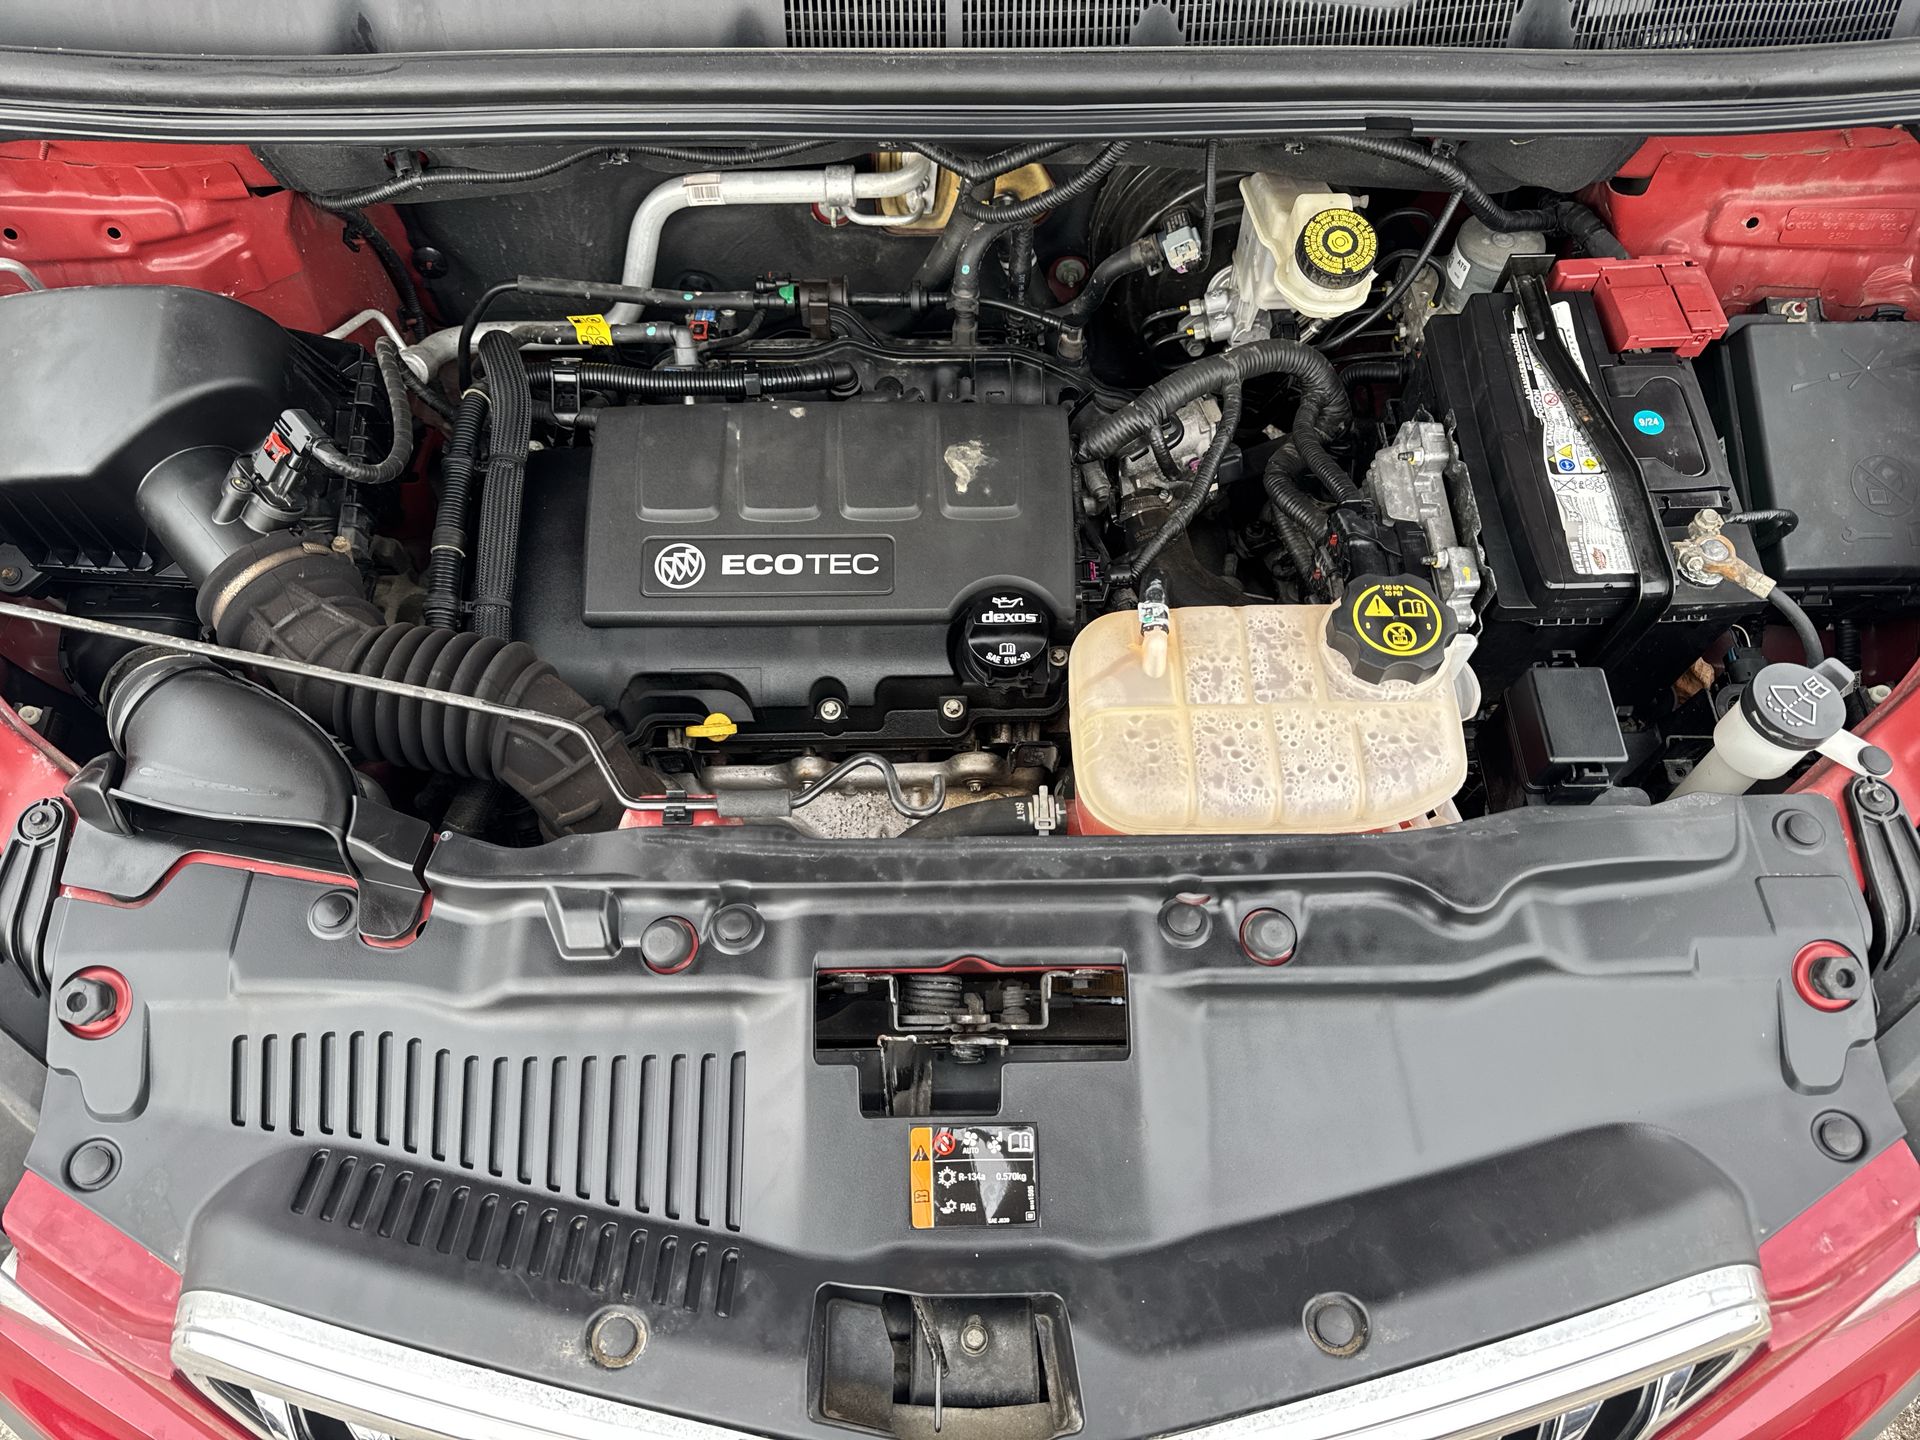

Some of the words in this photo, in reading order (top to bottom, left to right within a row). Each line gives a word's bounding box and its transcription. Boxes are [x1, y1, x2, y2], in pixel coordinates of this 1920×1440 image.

[1533, 389, 1545, 419] POISON
[1638, 417, 1660, 427] 9/24
[721, 553, 880, 576] ECOTEC
[981, 610, 1039, 623] dexos
[985, 651, 1002, 664] SAE
[1003, 651, 1032, 665] 5W-30
[962, 1147, 980, 1155] AUTO
[958, 1172, 986, 1181] R-134a
[995, 1172, 1027, 1183] 0.570kg
[960, 1203, 977, 1212] PAG
